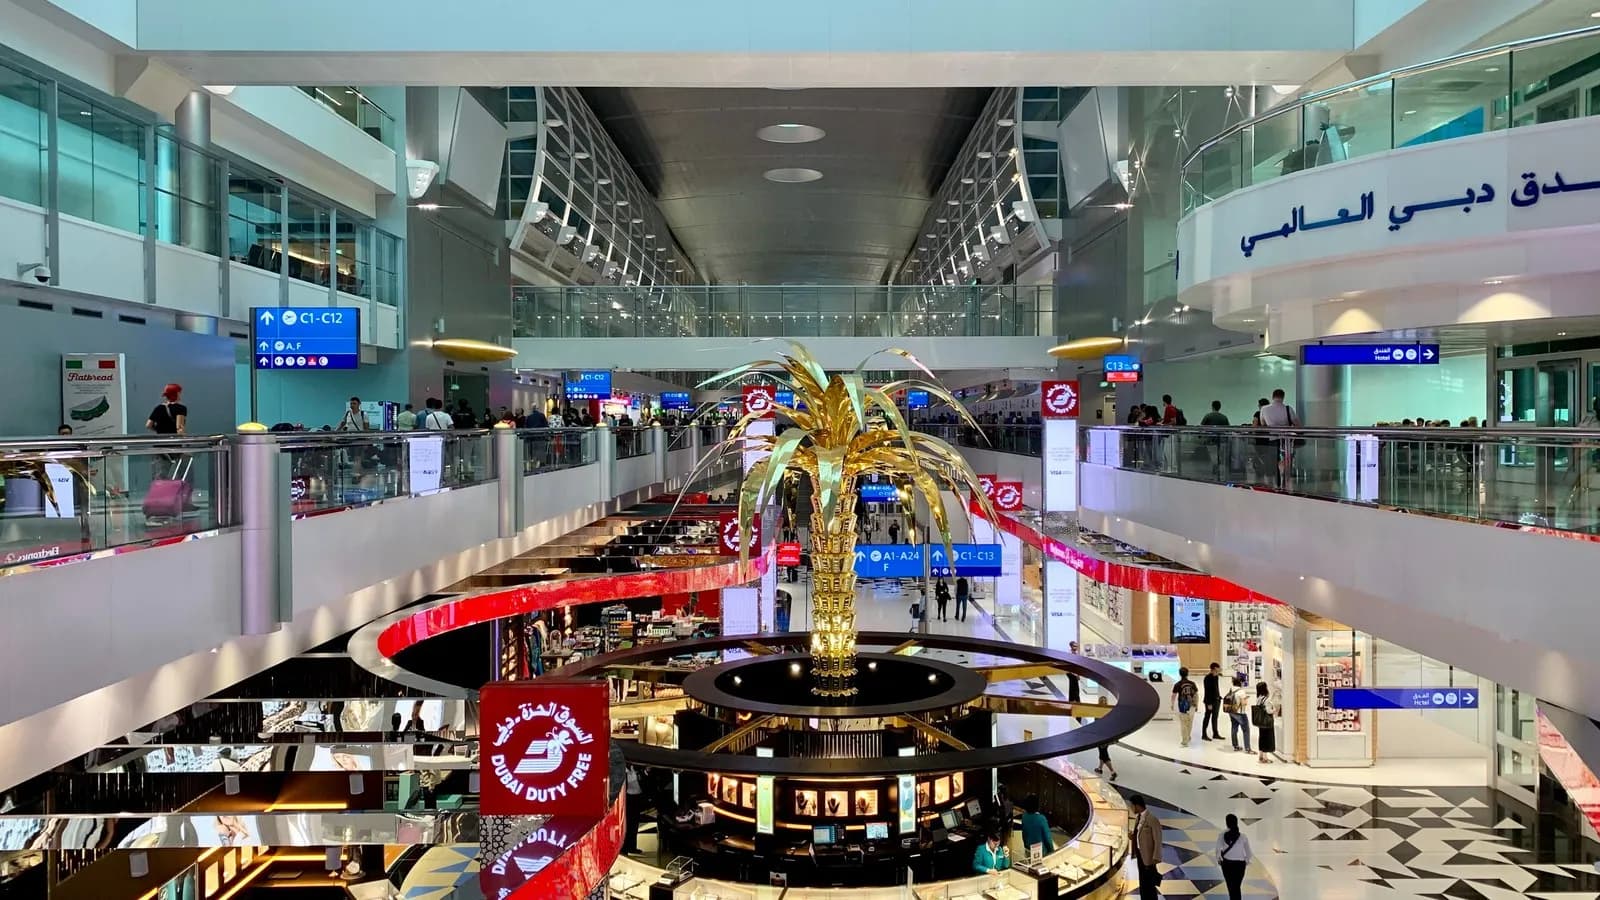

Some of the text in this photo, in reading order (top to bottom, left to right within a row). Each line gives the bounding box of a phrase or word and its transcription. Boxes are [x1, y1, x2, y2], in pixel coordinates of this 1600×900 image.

[1388, 181, 1496, 231] دبي
[1240, 190, 1375, 258] العالمي
[1106, 361, 1123, 370] C13
[67, 372, 114, 382] Flatbread
[883, 551, 920, 561] A1-A24
[960, 551, 995, 561] C1-C13
[883, 564, 889, 572] F
[518, 701, 557, 721] الحرة
[492, 716, 515, 747] دبي
[554, 704, 594, 745] السوق
[491, 752, 592, 803] DUBAI DUTY FREE
